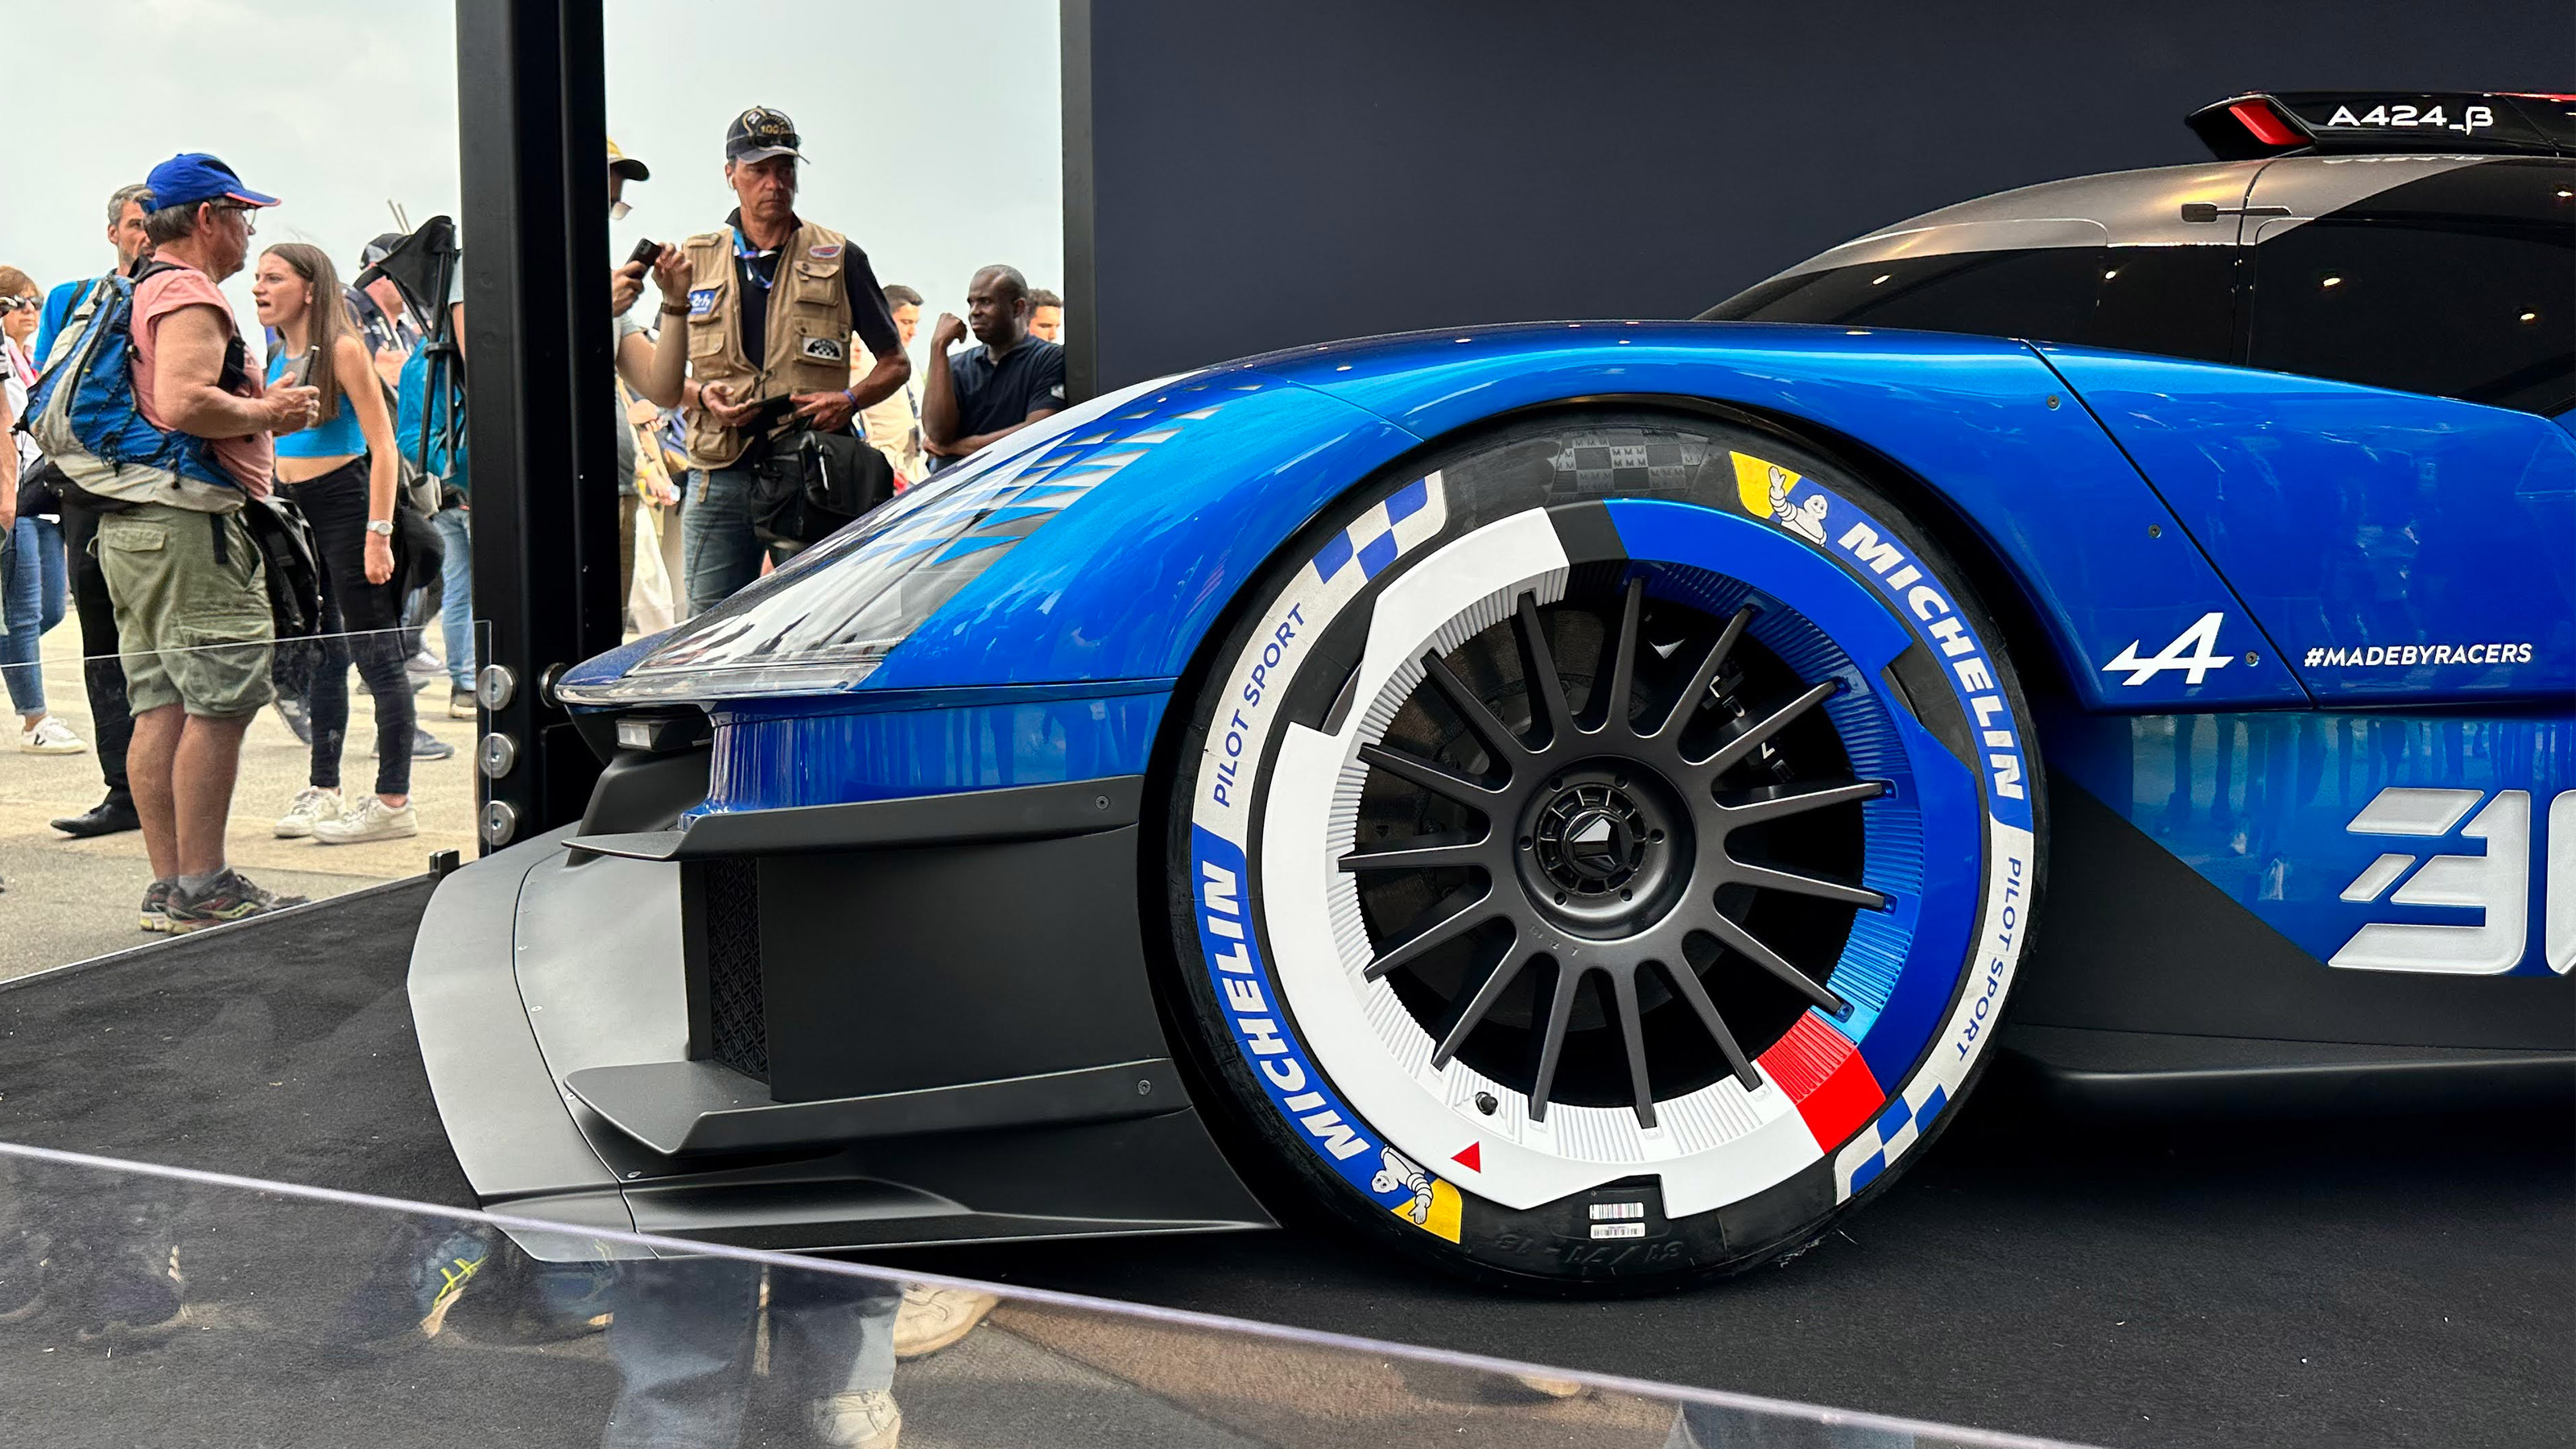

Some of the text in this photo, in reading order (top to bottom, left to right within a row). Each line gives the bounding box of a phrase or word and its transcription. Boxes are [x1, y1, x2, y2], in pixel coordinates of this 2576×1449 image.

[1213, 603, 1305, 807] PILOT SPORT
[1837, 522, 2024, 799] MICHELIN
[2304, 643, 2533, 667] #MADEBYRACERS
[1956, 857, 2021, 1062] PILOT SPORT
[2327, 786, 2576, 975] 3
[1202, 861, 1371, 1161] MICHELIN
